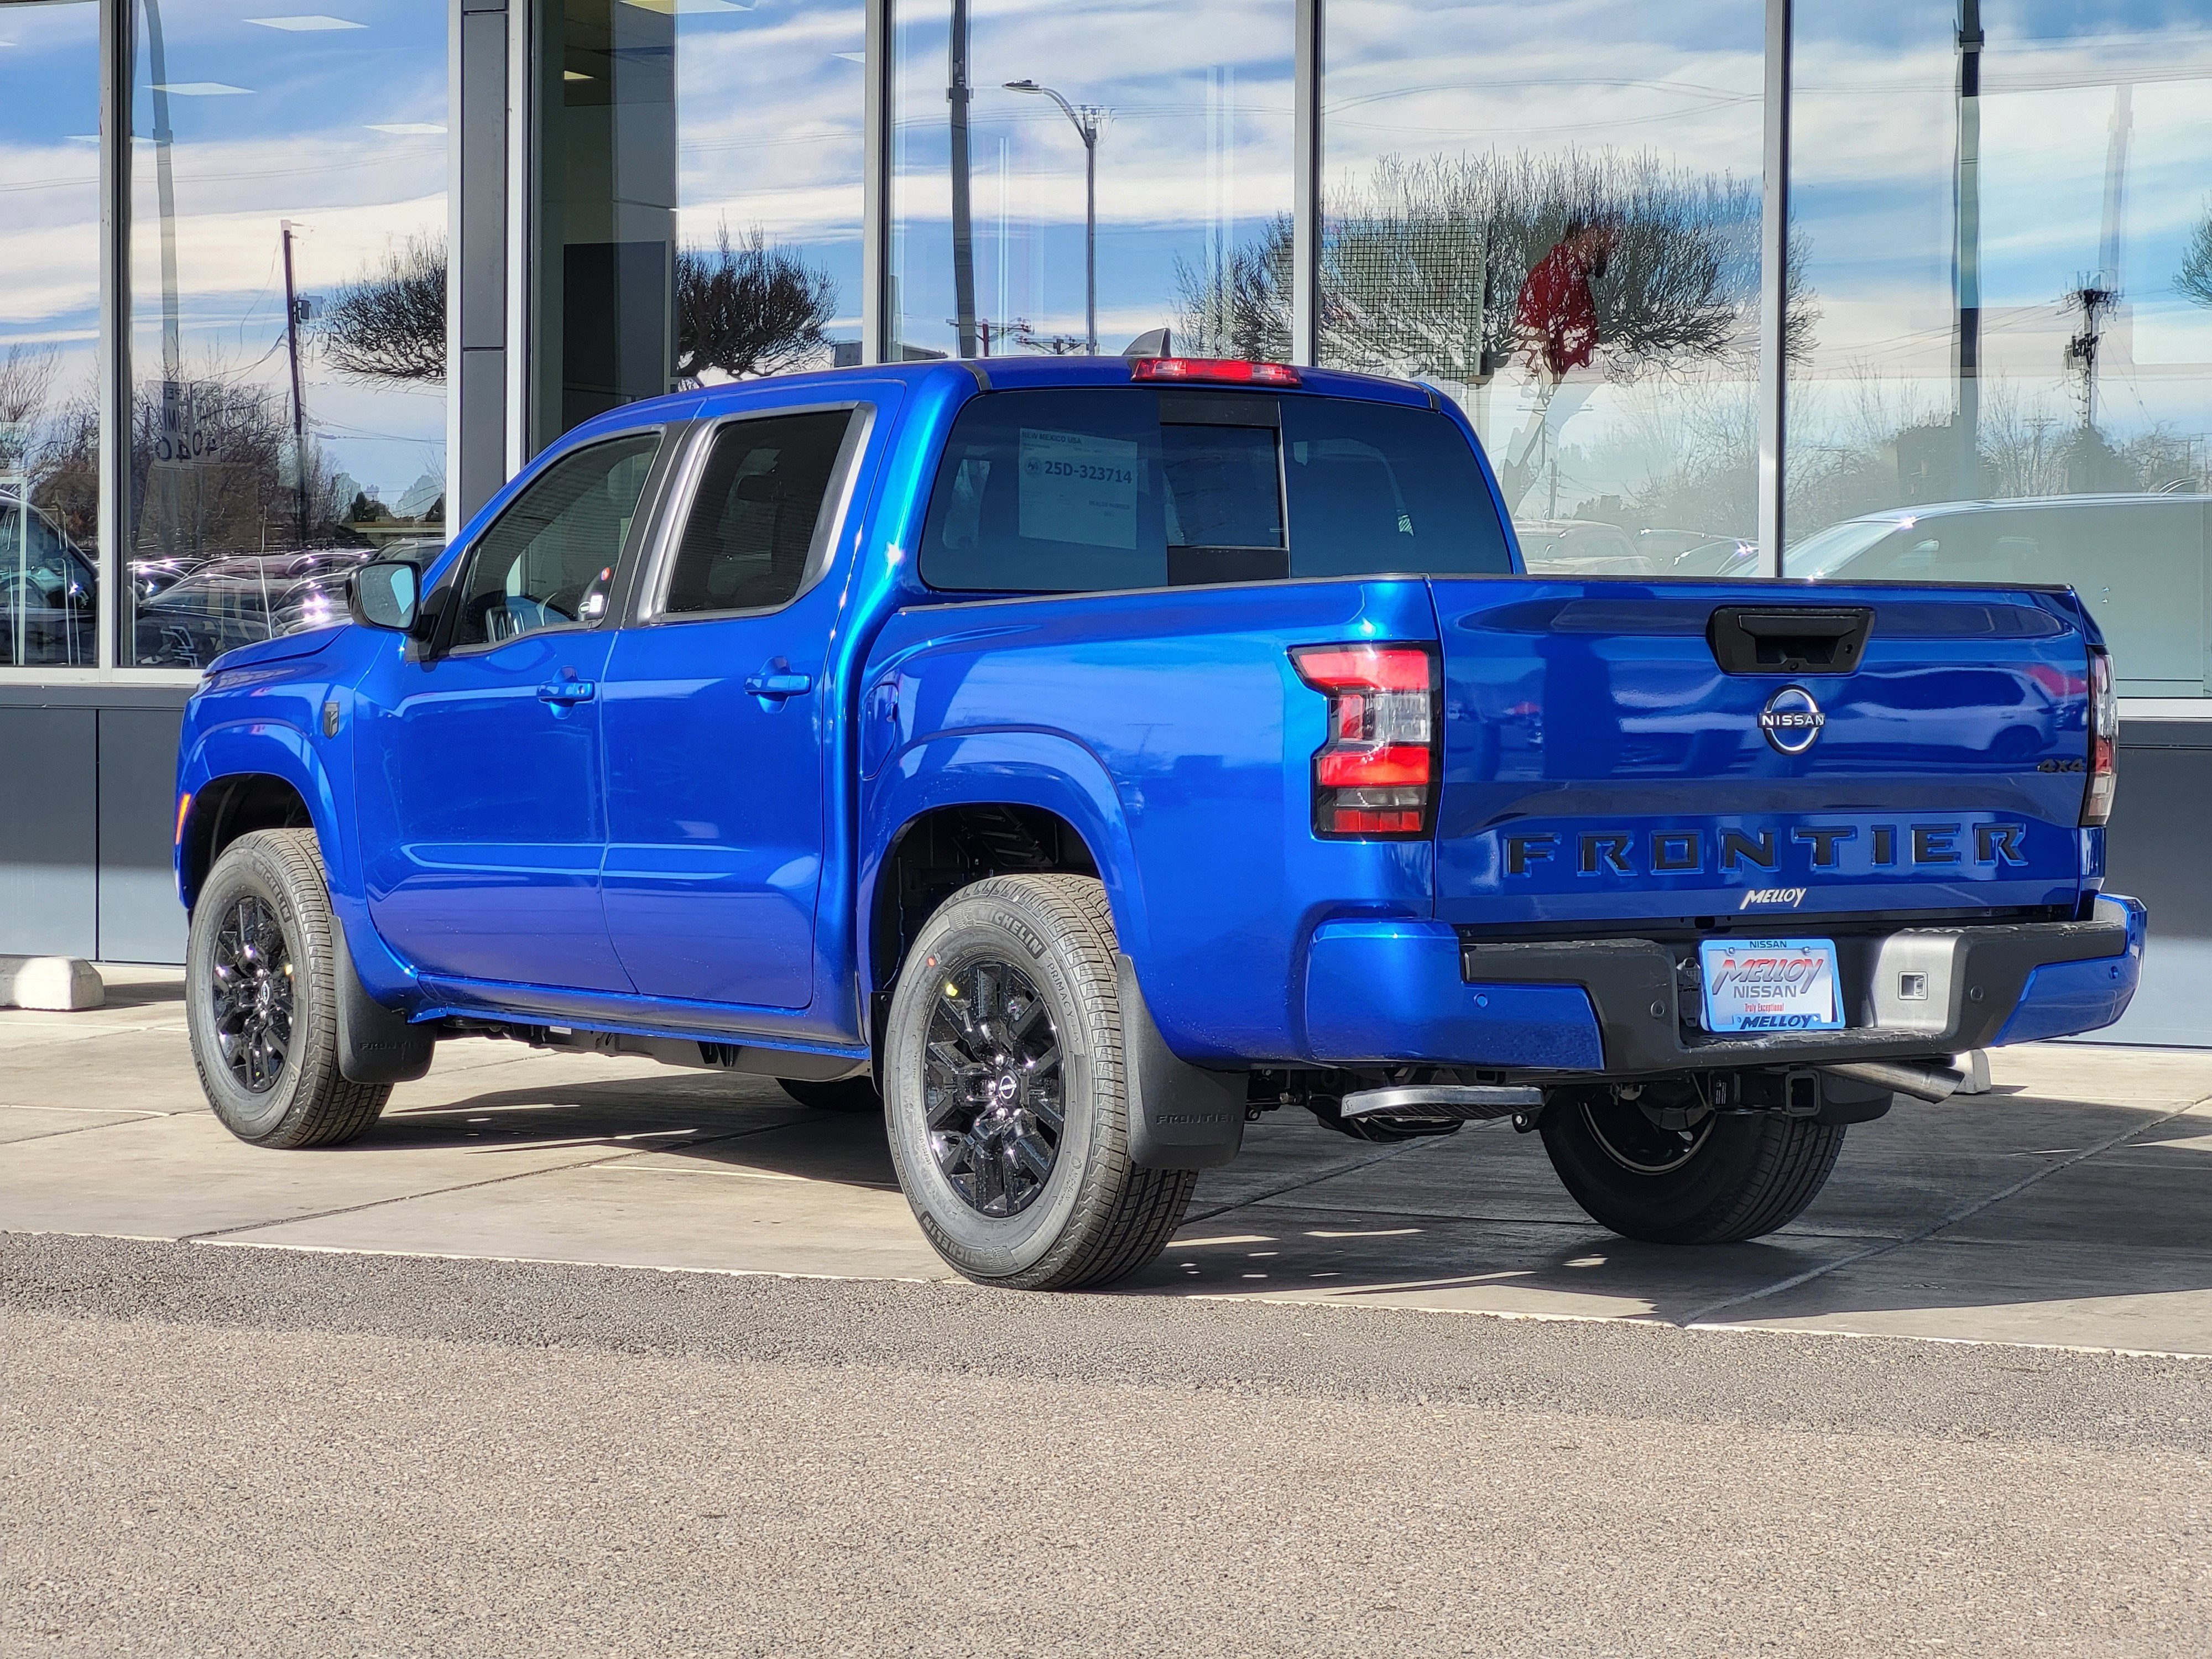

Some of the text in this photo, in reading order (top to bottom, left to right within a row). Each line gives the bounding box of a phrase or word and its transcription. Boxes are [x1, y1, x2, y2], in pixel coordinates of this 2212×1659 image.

[1039, 434, 1066, 443] MEXICO
[1067, 436, 1082, 444] USA
[1045, 460, 1133, 484] 25D-323714
[1762, 714, 1824, 726] NISSAN
[1503, 822, 2028, 878] FRONTIER
[1739, 888, 1807, 910] MELLOY
[1712, 959, 1824, 995] MELLOY
[1046, 962, 1074, 1018] PRIMACY
[1734, 985, 1797, 998] NISSAN
[1745, 1003, 1785, 1013] Truly Exceptional
[1740, 1015, 1812, 1030] MELLOY
